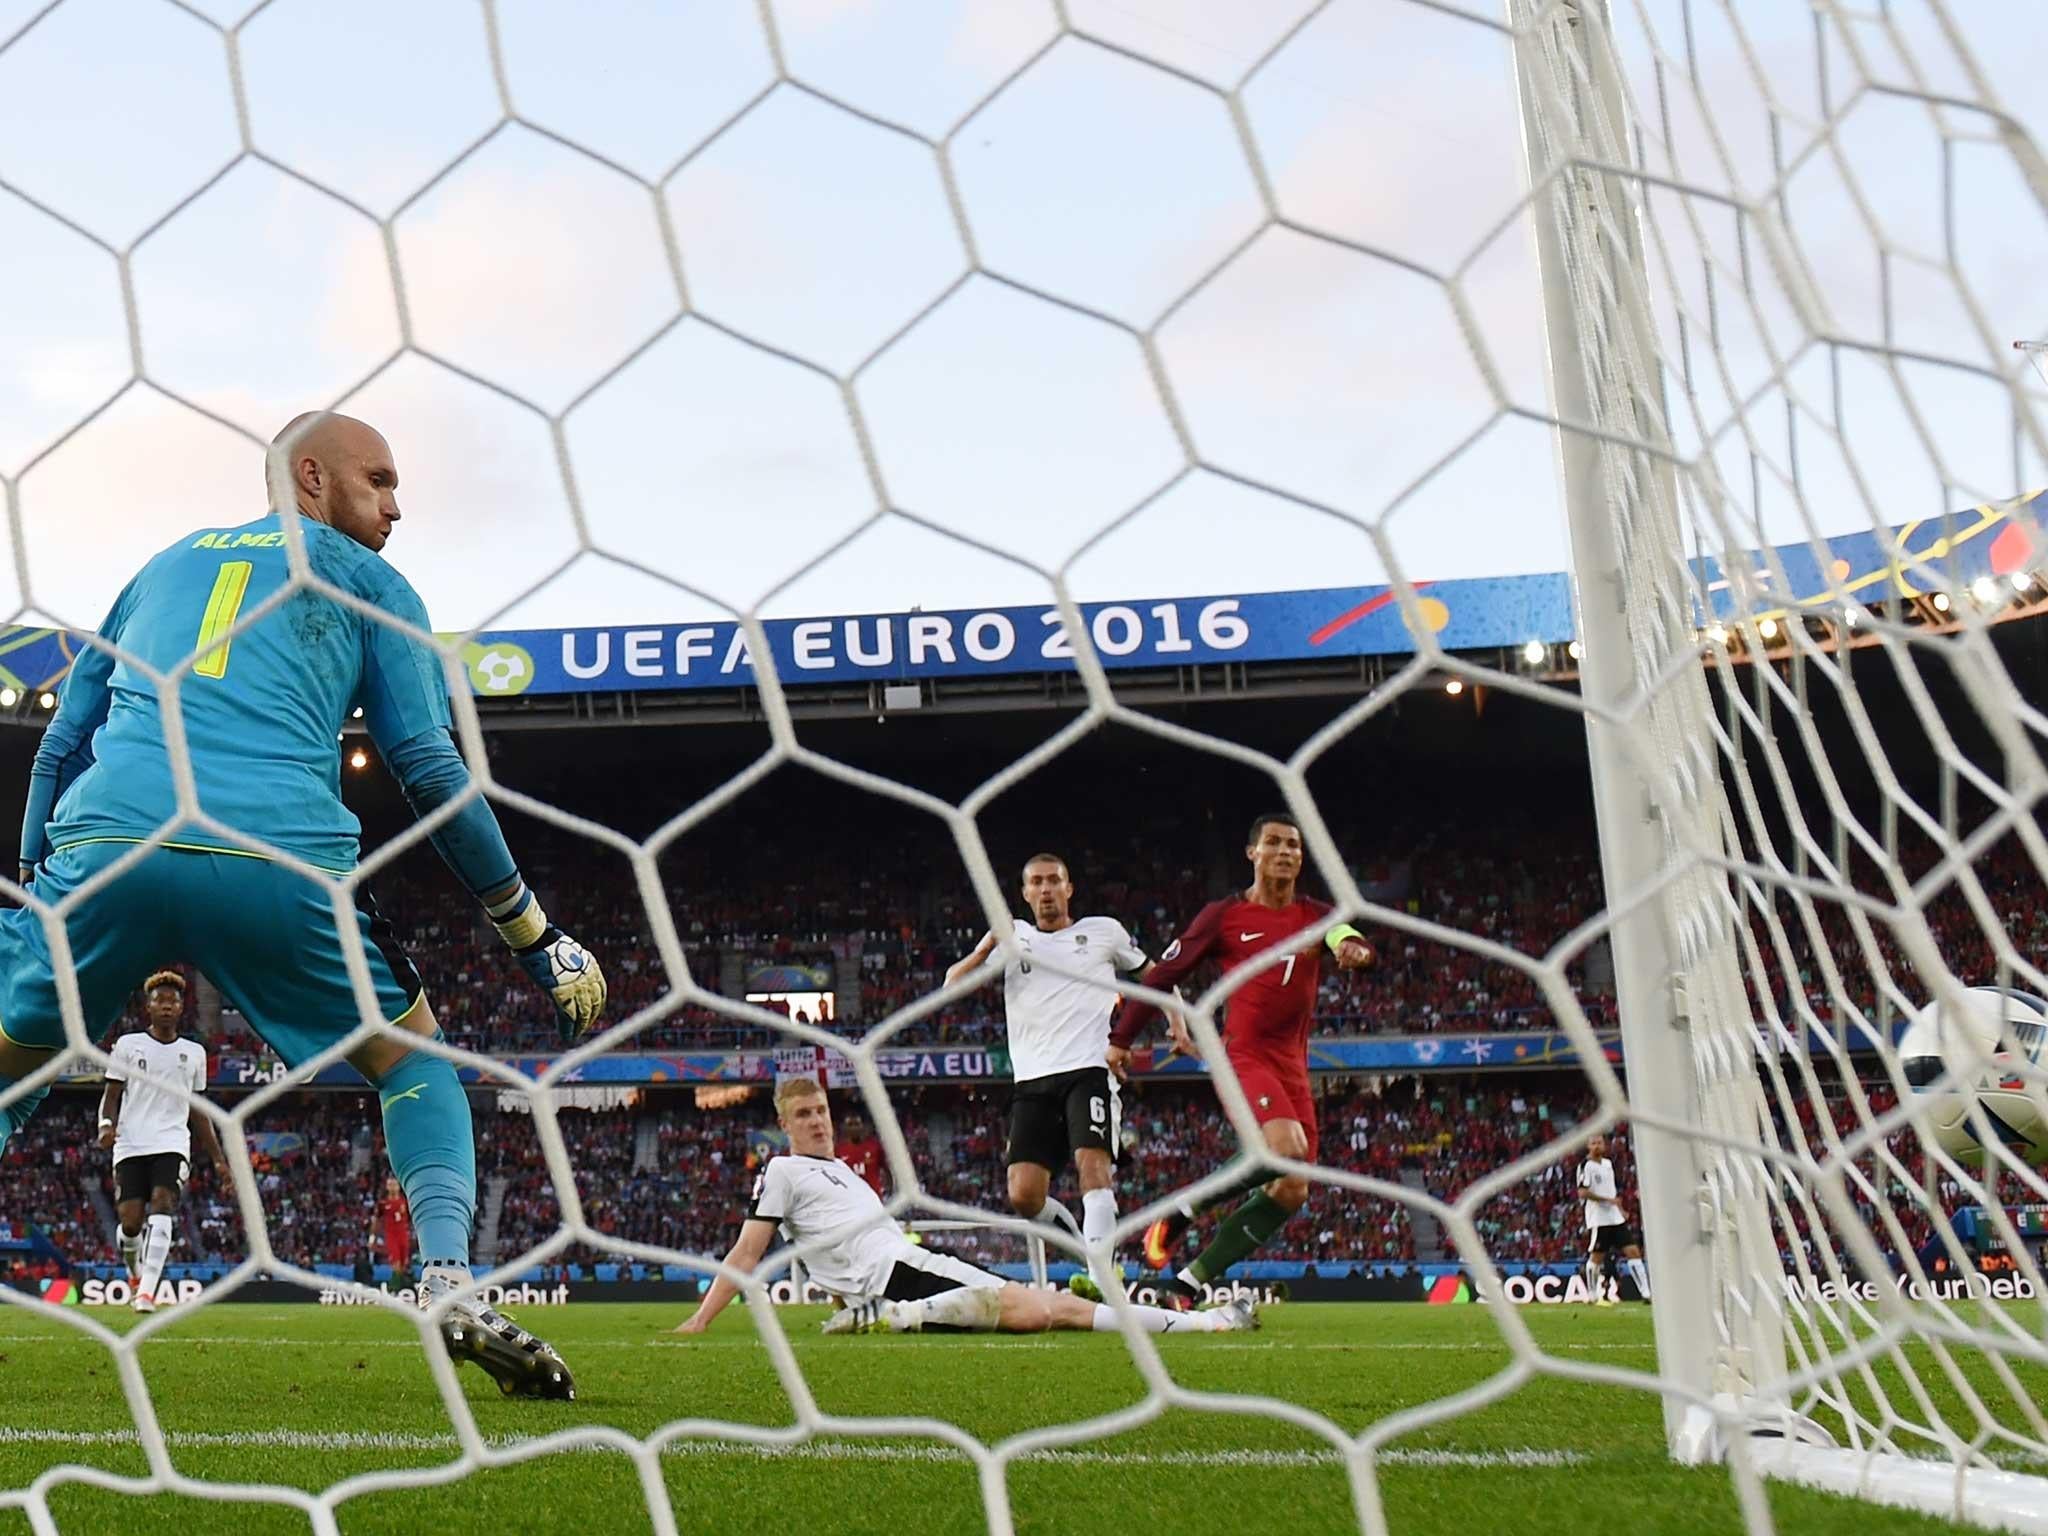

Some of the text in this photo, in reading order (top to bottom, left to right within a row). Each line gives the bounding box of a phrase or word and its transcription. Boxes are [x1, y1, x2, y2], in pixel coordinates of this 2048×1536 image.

[192, 561, 253, 680] 1
[562, 600, 1250, 679] UEFA EURO 2016
[1280, 954, 1297, 987] 7
[1089, 1096, 1105, 1124] 6
[82, 1279, 204, 1305] SOAR
